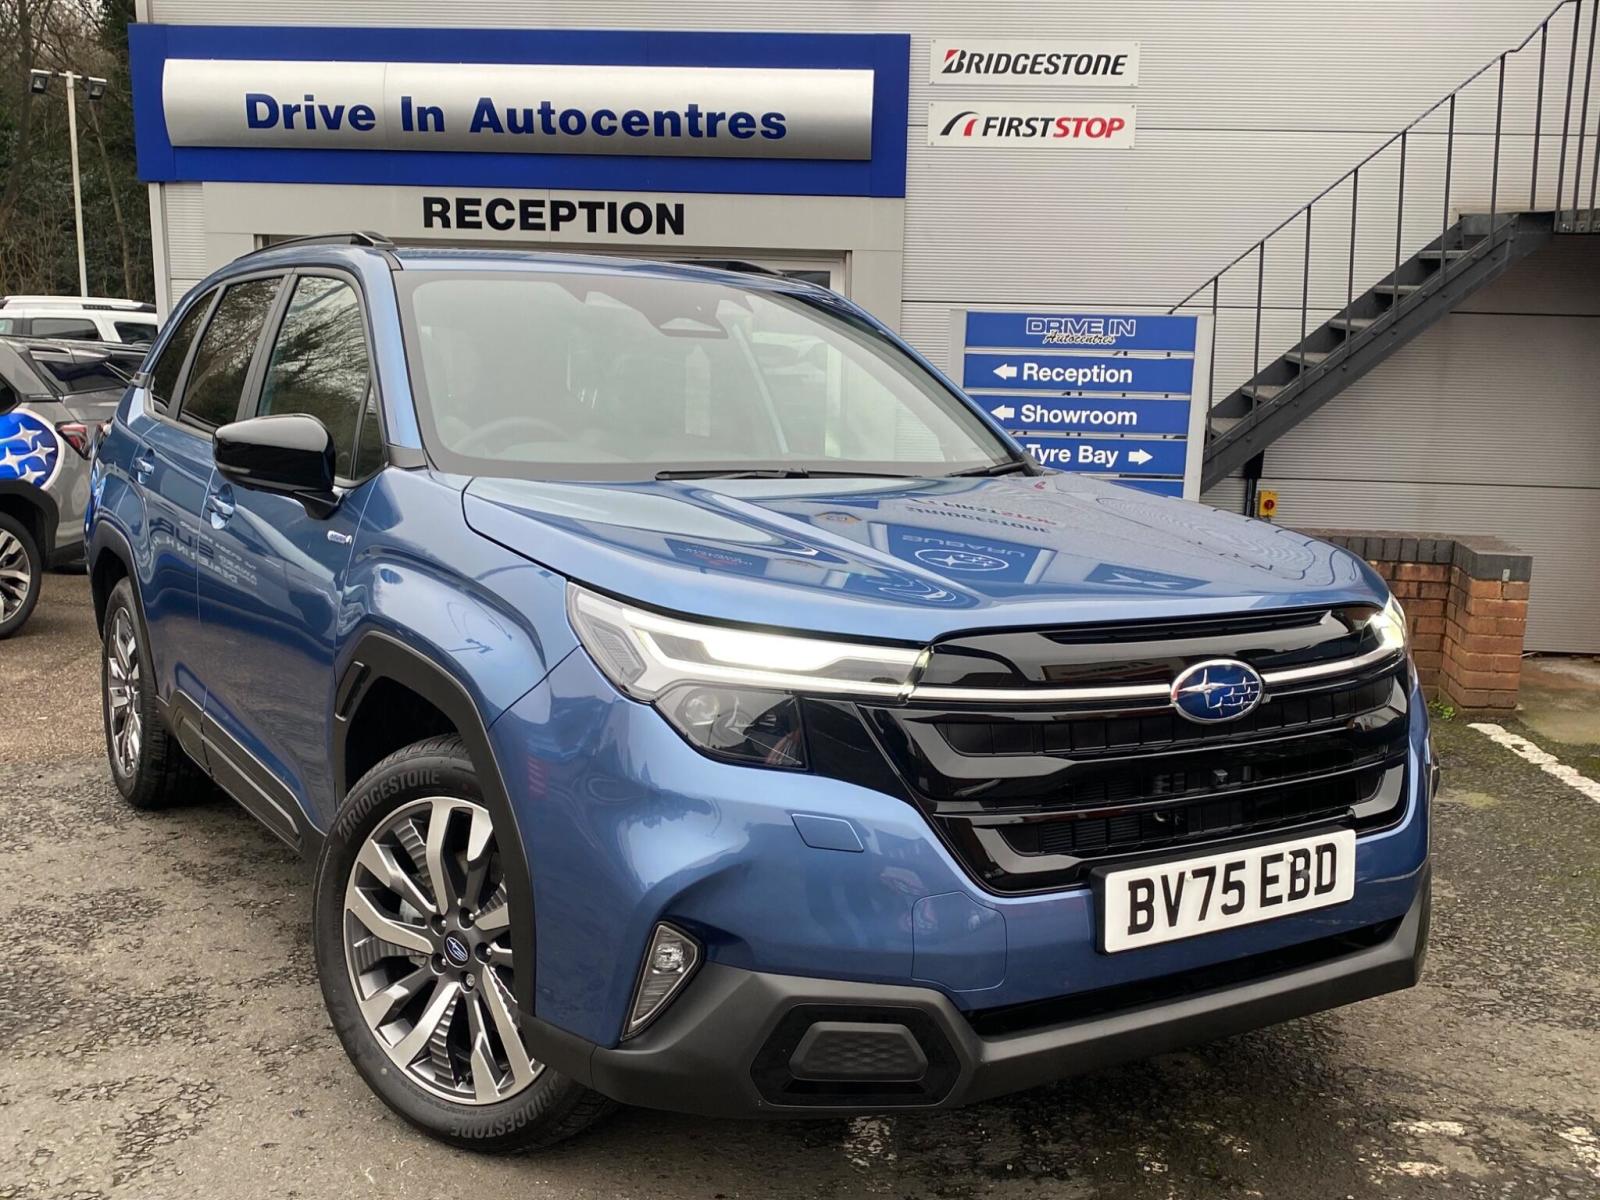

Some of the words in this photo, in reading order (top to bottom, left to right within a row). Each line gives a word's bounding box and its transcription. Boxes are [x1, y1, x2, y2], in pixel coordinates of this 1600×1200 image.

[941, 48, 1129, 76] BRIDGESTONE
[246, 93, 375, 131] Drive
[402, 96, 444, 132] In
[470, 97, 787, 139] Autocentres
[423, 196, 685, 236] RECEPTION
[1025, 317, 1104, 336] DRIVE
[1109, 319, 1136, 337] IN
[1042, 330, 1116, 345] Autocentres
[1022, 362, 1133, 386] Reception
[1020, 404, 1138, 426] Showroom
[1026, 443, 1072, 465] Tyre
[1078, 445, 1119, 468] Bay
[337, 768, 441, 843] BRIDGESTONE
[1127, 860, 1247, 936] BV75
[1259, 843, 1337, 908] EBD
